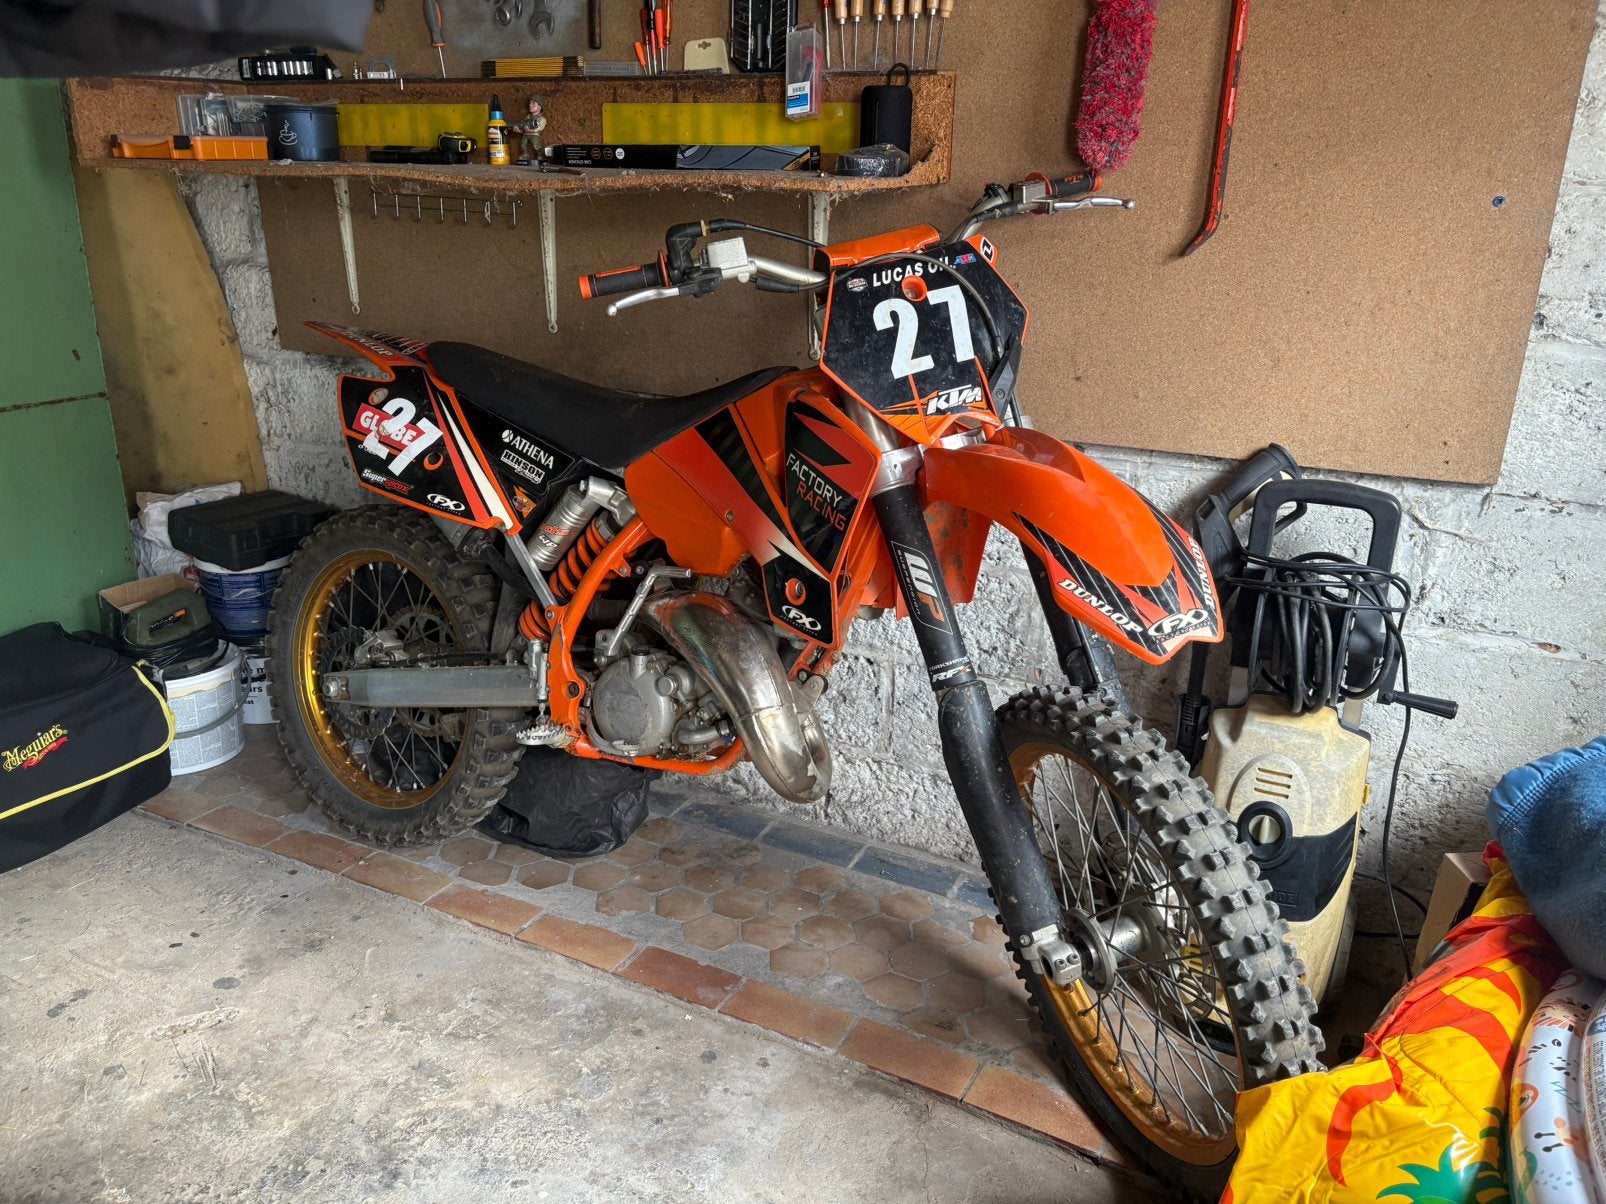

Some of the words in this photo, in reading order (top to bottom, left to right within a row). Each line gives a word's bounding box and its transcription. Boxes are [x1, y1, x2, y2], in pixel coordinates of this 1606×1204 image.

[872, 262, 924, 287] LUCAS
[873, 285, 975, 379] 27
[927, 384, 983, 415] KTM
[363, 398, 443, 477] 27
[510, 436, 554, 469] ATHENA
[503, 450, 544, 479] HINSON
[786, 453, 842, 507] FACTORY
[429, 494, 466, 511] FX
[797, 481, 847, 531] RACING
[1188, 537, 1215, 610] DUNLOP
[783, 605, 821, 630] FX
[1058, 578, 1144, 634] DUNLOP
[1149, 609, 1209, 636] FX
